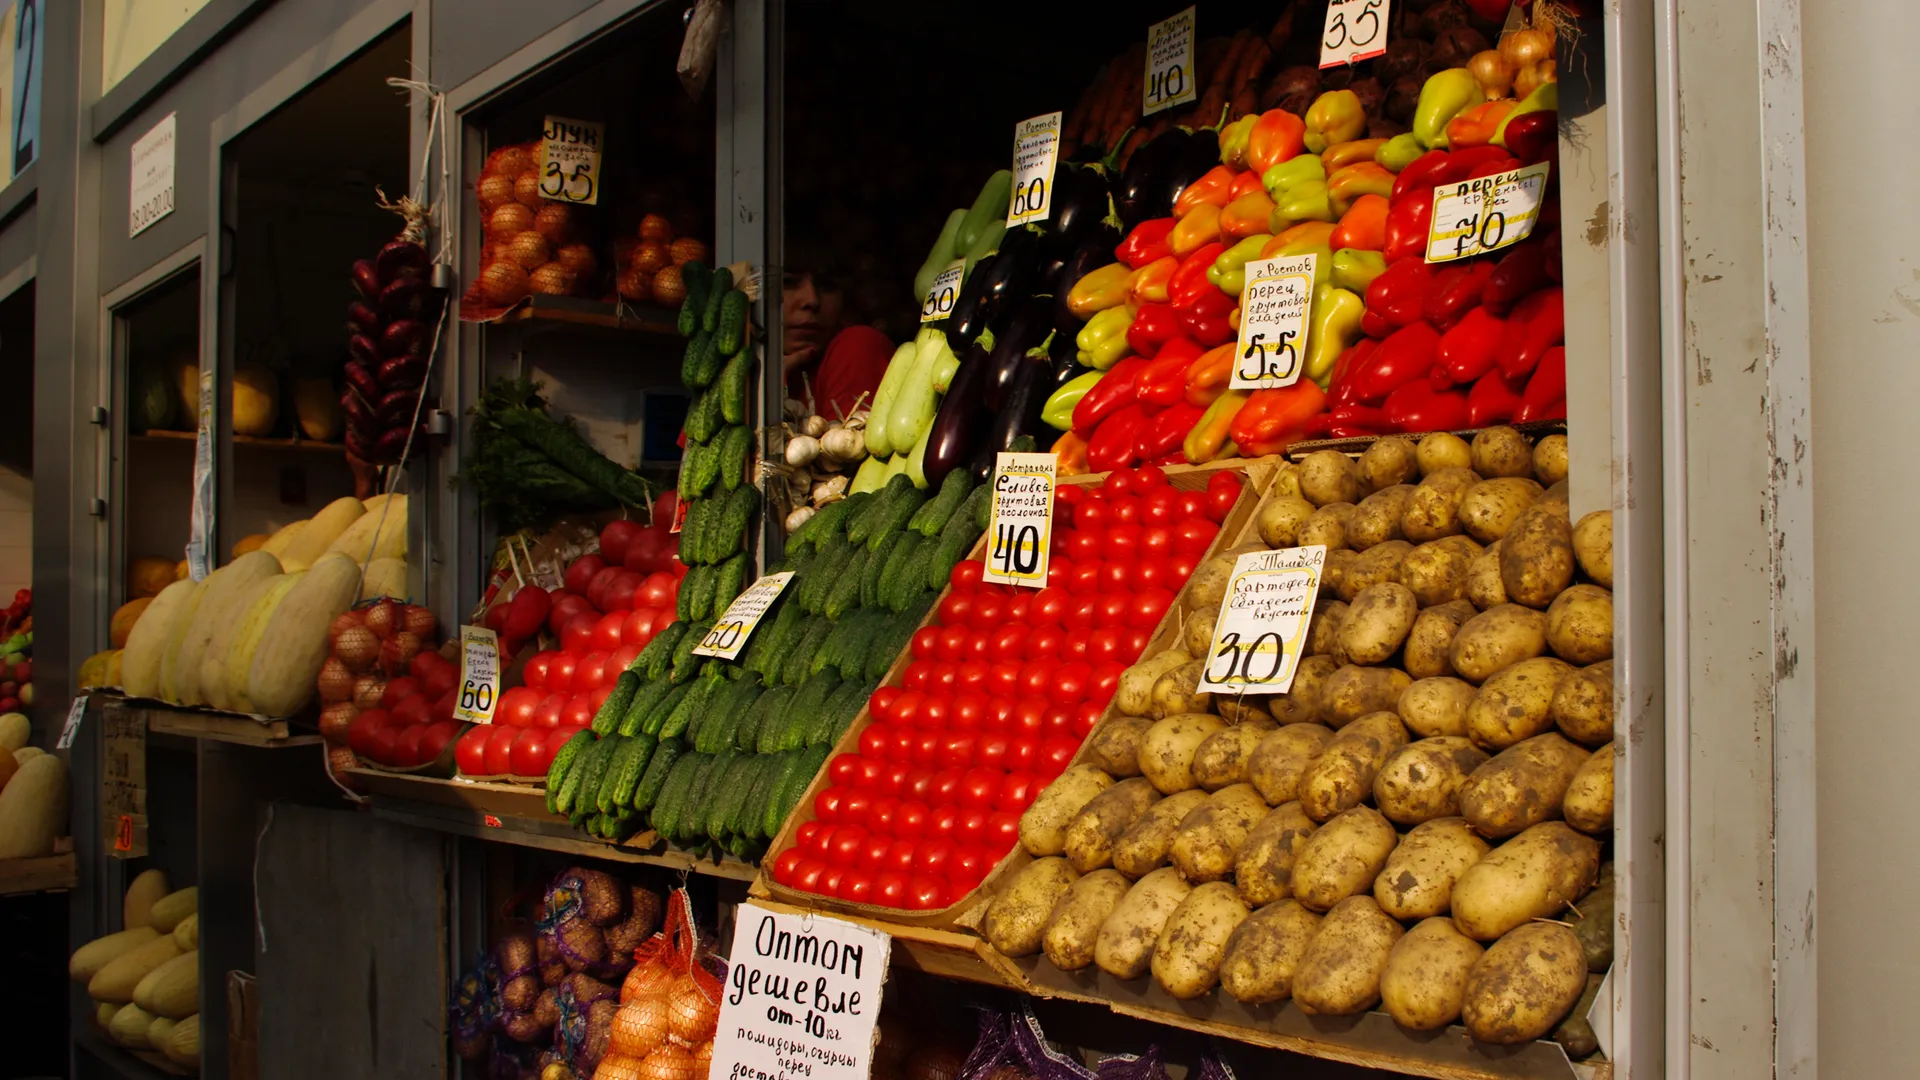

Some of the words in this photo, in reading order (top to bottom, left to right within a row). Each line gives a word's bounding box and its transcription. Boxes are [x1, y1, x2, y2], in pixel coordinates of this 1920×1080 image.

[1326, 0, 1381, 49] 35
[1148, 65, 1183, 102] 40
[540, 161, 593, 201] 35
[1014, 178, 1044, 216] 60
[1454, 212, 1505, 257] 70
[1268, 257, 1311, 277] Ростов
[923, 287, 954, 315] 30
[1249, 307, 1302, 325] сладкий
[1239, 330, 1296, 381] 55
[996, 475, 1052, 493] Сливка
[994, 523, 1039, 574] 40
[1234, 577, 1316, 595] Картофель
[703, 620, 743, 649] 60
[1205, 632, 1283, 684] 30
[461, 680, 492, 711] 60
[756, 916, 863, 979] Оптом
[729, 964, 861, 1015] дешевле
